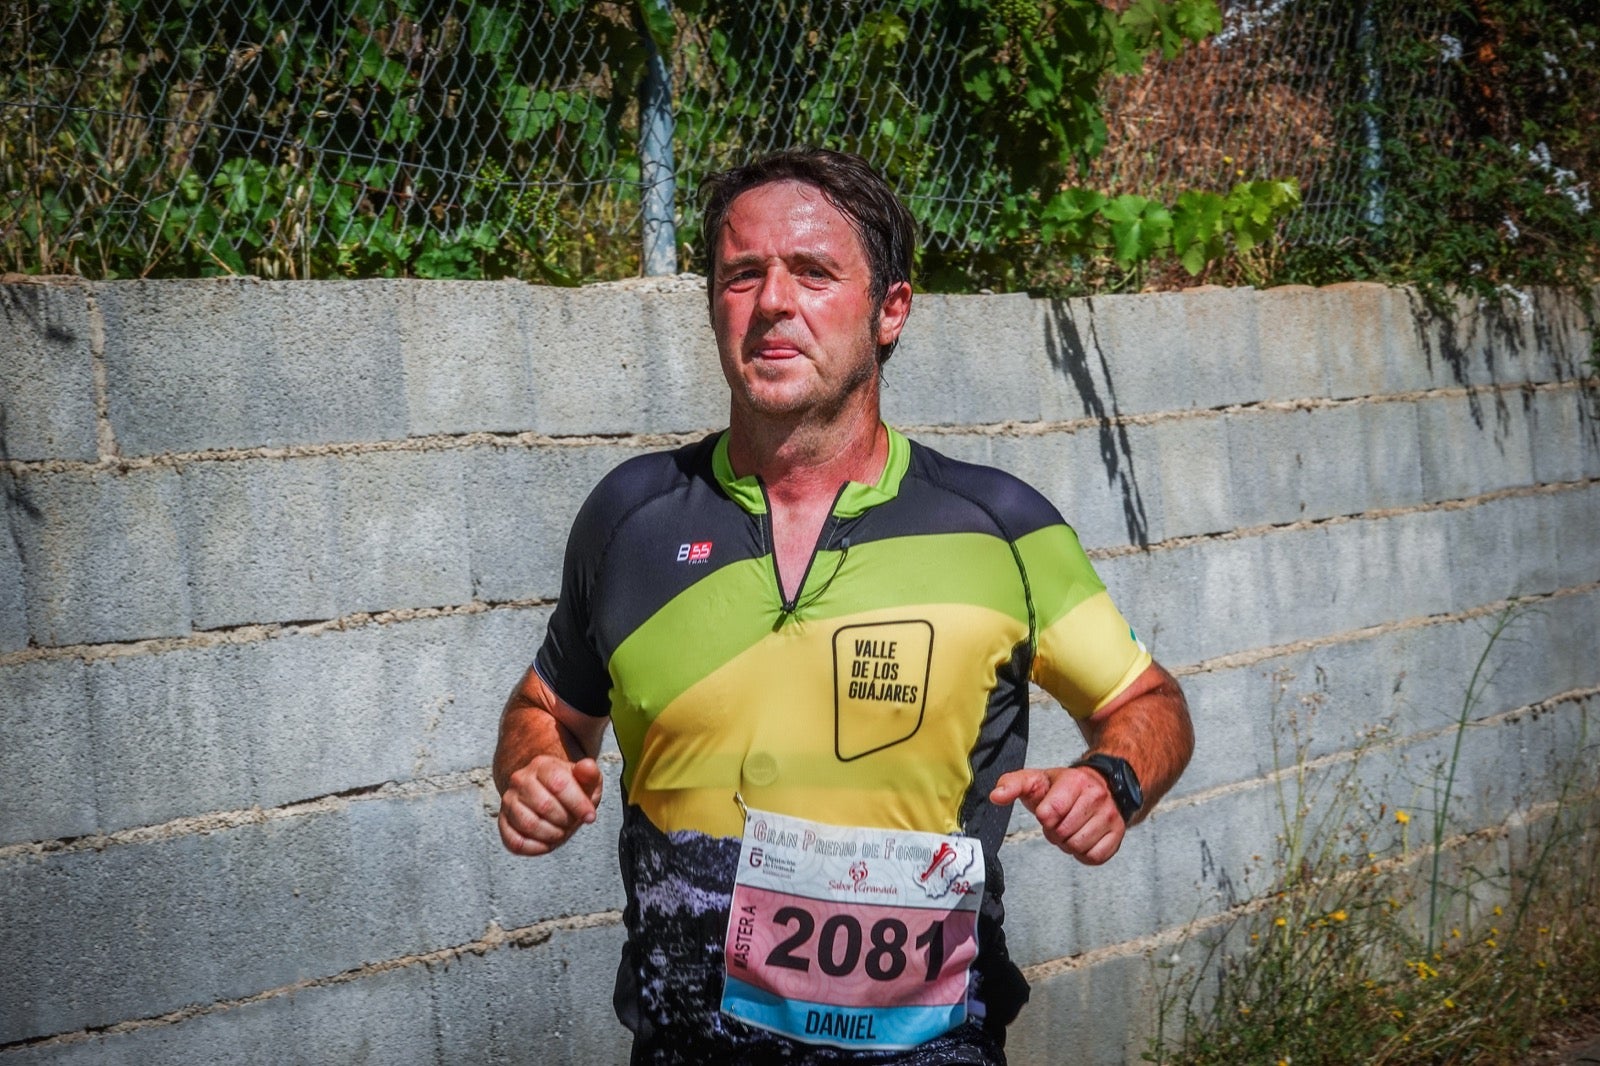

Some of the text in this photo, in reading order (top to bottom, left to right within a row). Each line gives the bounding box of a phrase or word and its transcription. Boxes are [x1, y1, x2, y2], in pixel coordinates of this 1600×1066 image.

[854, 639, 897, 659] VALLE
[851, 660, 899, 681] DE LOS
[862, 842, 880, 857] DE
[828, 880, 853, 891] Sabor
[741, 905, 757, 916] A
[765, 906, 944, 982] 2081
[804, 1010, 876, 1039] DANIEL
